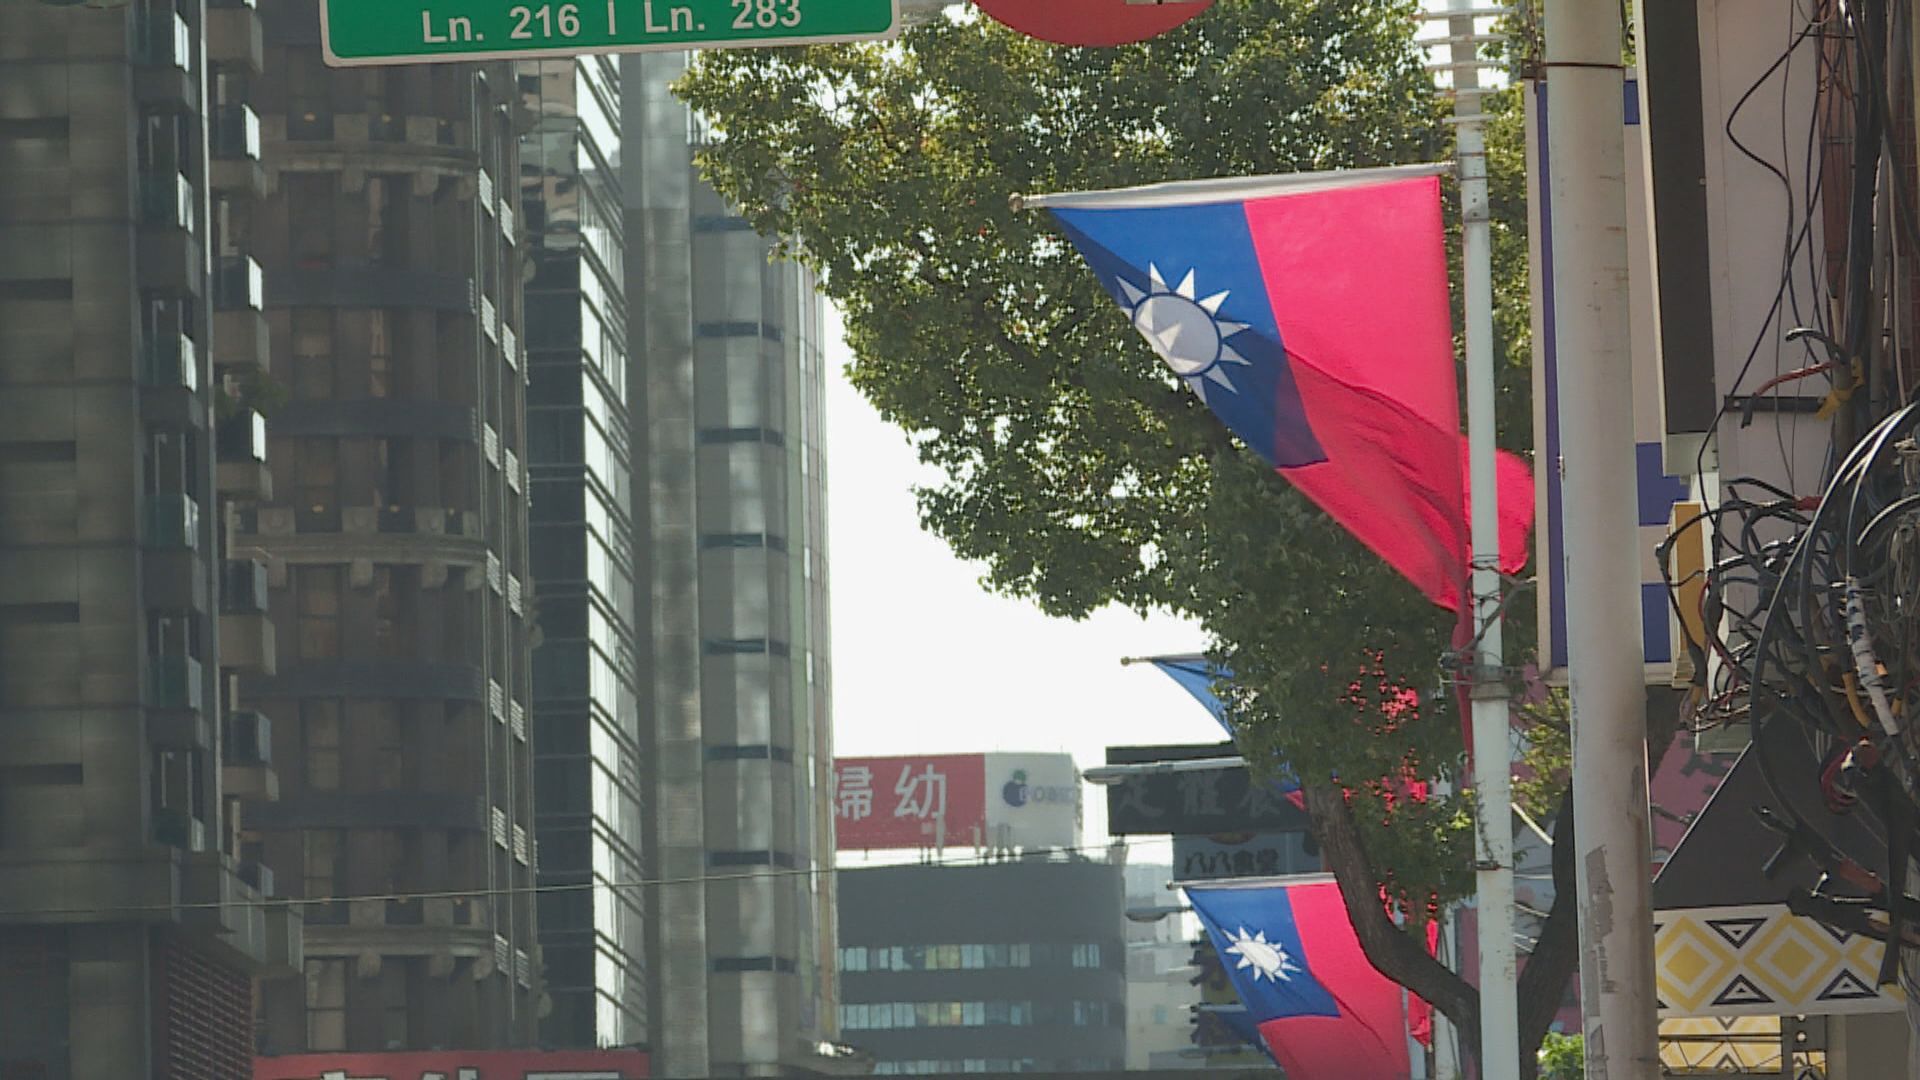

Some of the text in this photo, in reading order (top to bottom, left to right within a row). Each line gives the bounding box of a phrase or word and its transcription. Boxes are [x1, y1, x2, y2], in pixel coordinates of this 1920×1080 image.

[422, 0, 802, 43] Ln. 216 Ln. 283
[834, 763, 948, 821] 婦幼
